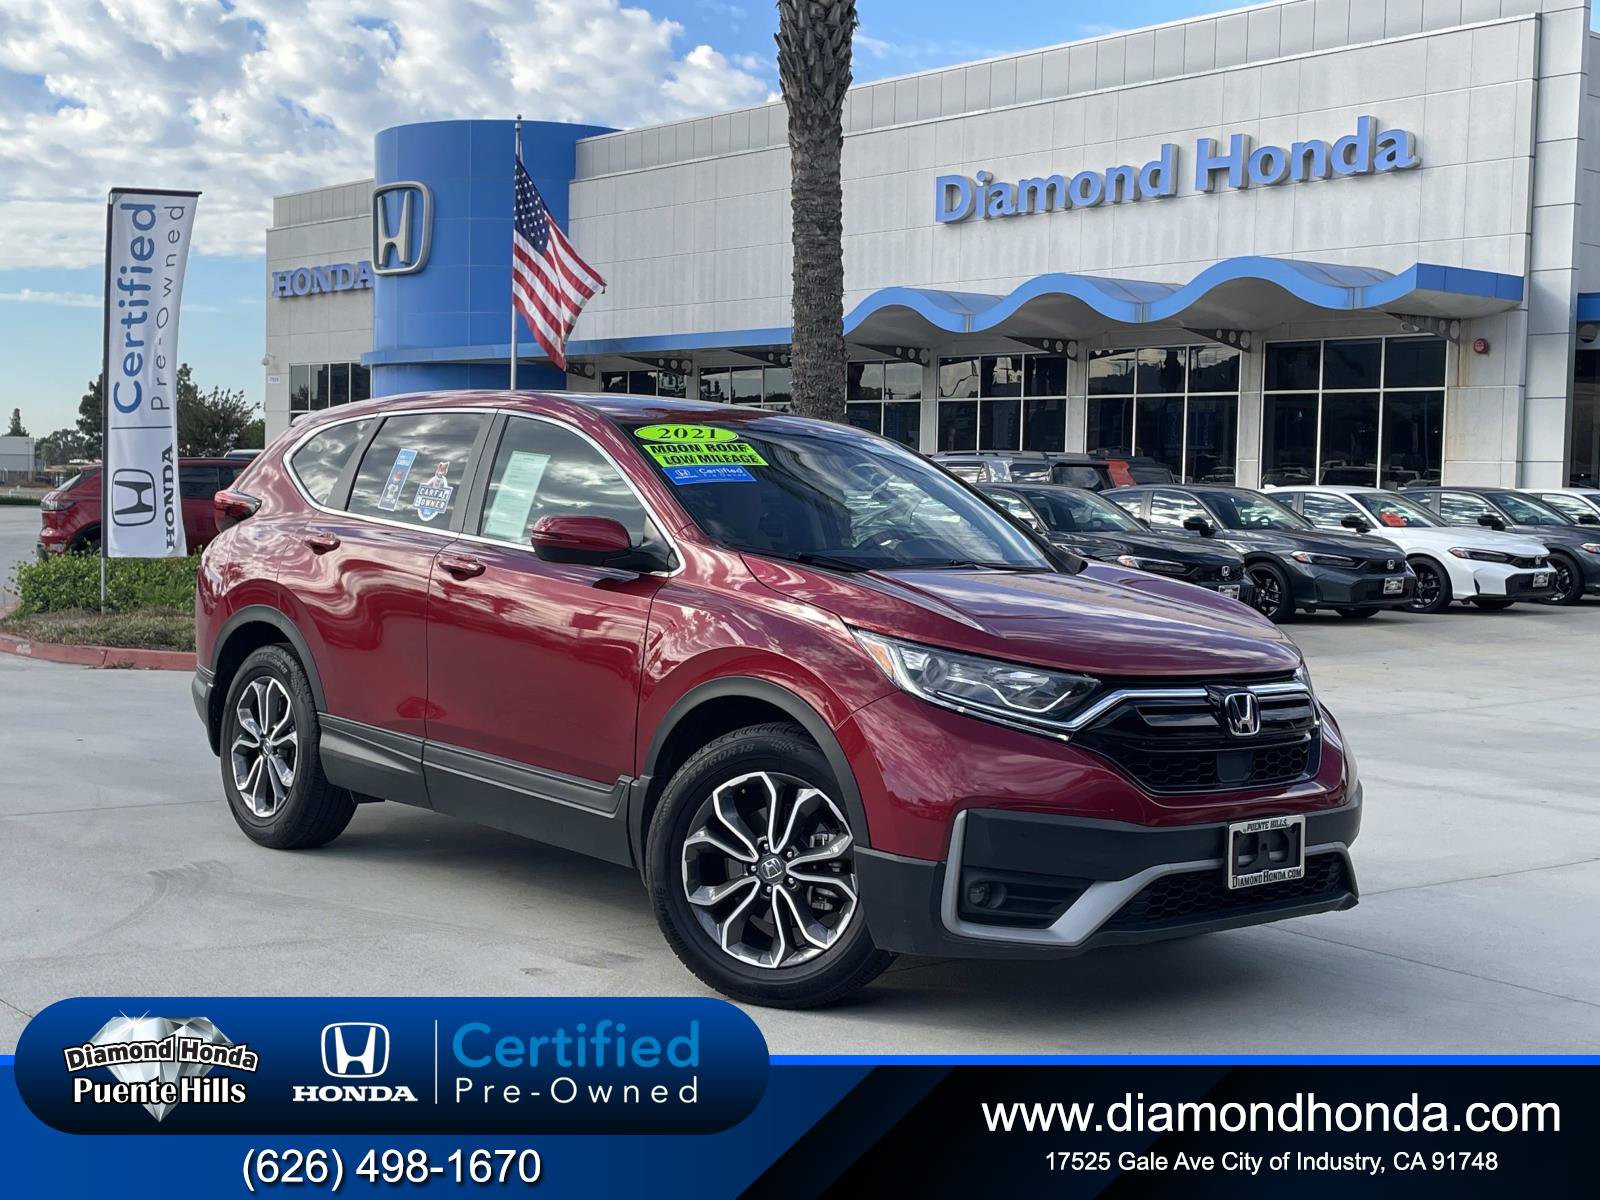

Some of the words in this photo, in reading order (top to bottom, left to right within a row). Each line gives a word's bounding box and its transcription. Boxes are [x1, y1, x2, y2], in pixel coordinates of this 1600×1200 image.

[936, 143, 1179, 223] Diamond
[1195, 115, 1421, 192] Honda
[272, 260, 374, 297] HONDA
[113, 202, 156, 413] Certified
[151, 205, 185, 411] Pre-Owned
[649, 444, 700, 453] MOON
[704, 443, 749, 452] ROOF
[658, 428, 717, 439] 2021
[662, 455, 695, 465] LOW
[696, 454, 760, 464] MILEAGE
[162, 443, 175, 548] HONDA
[1247, 821, 1269, 832] PUENTE
